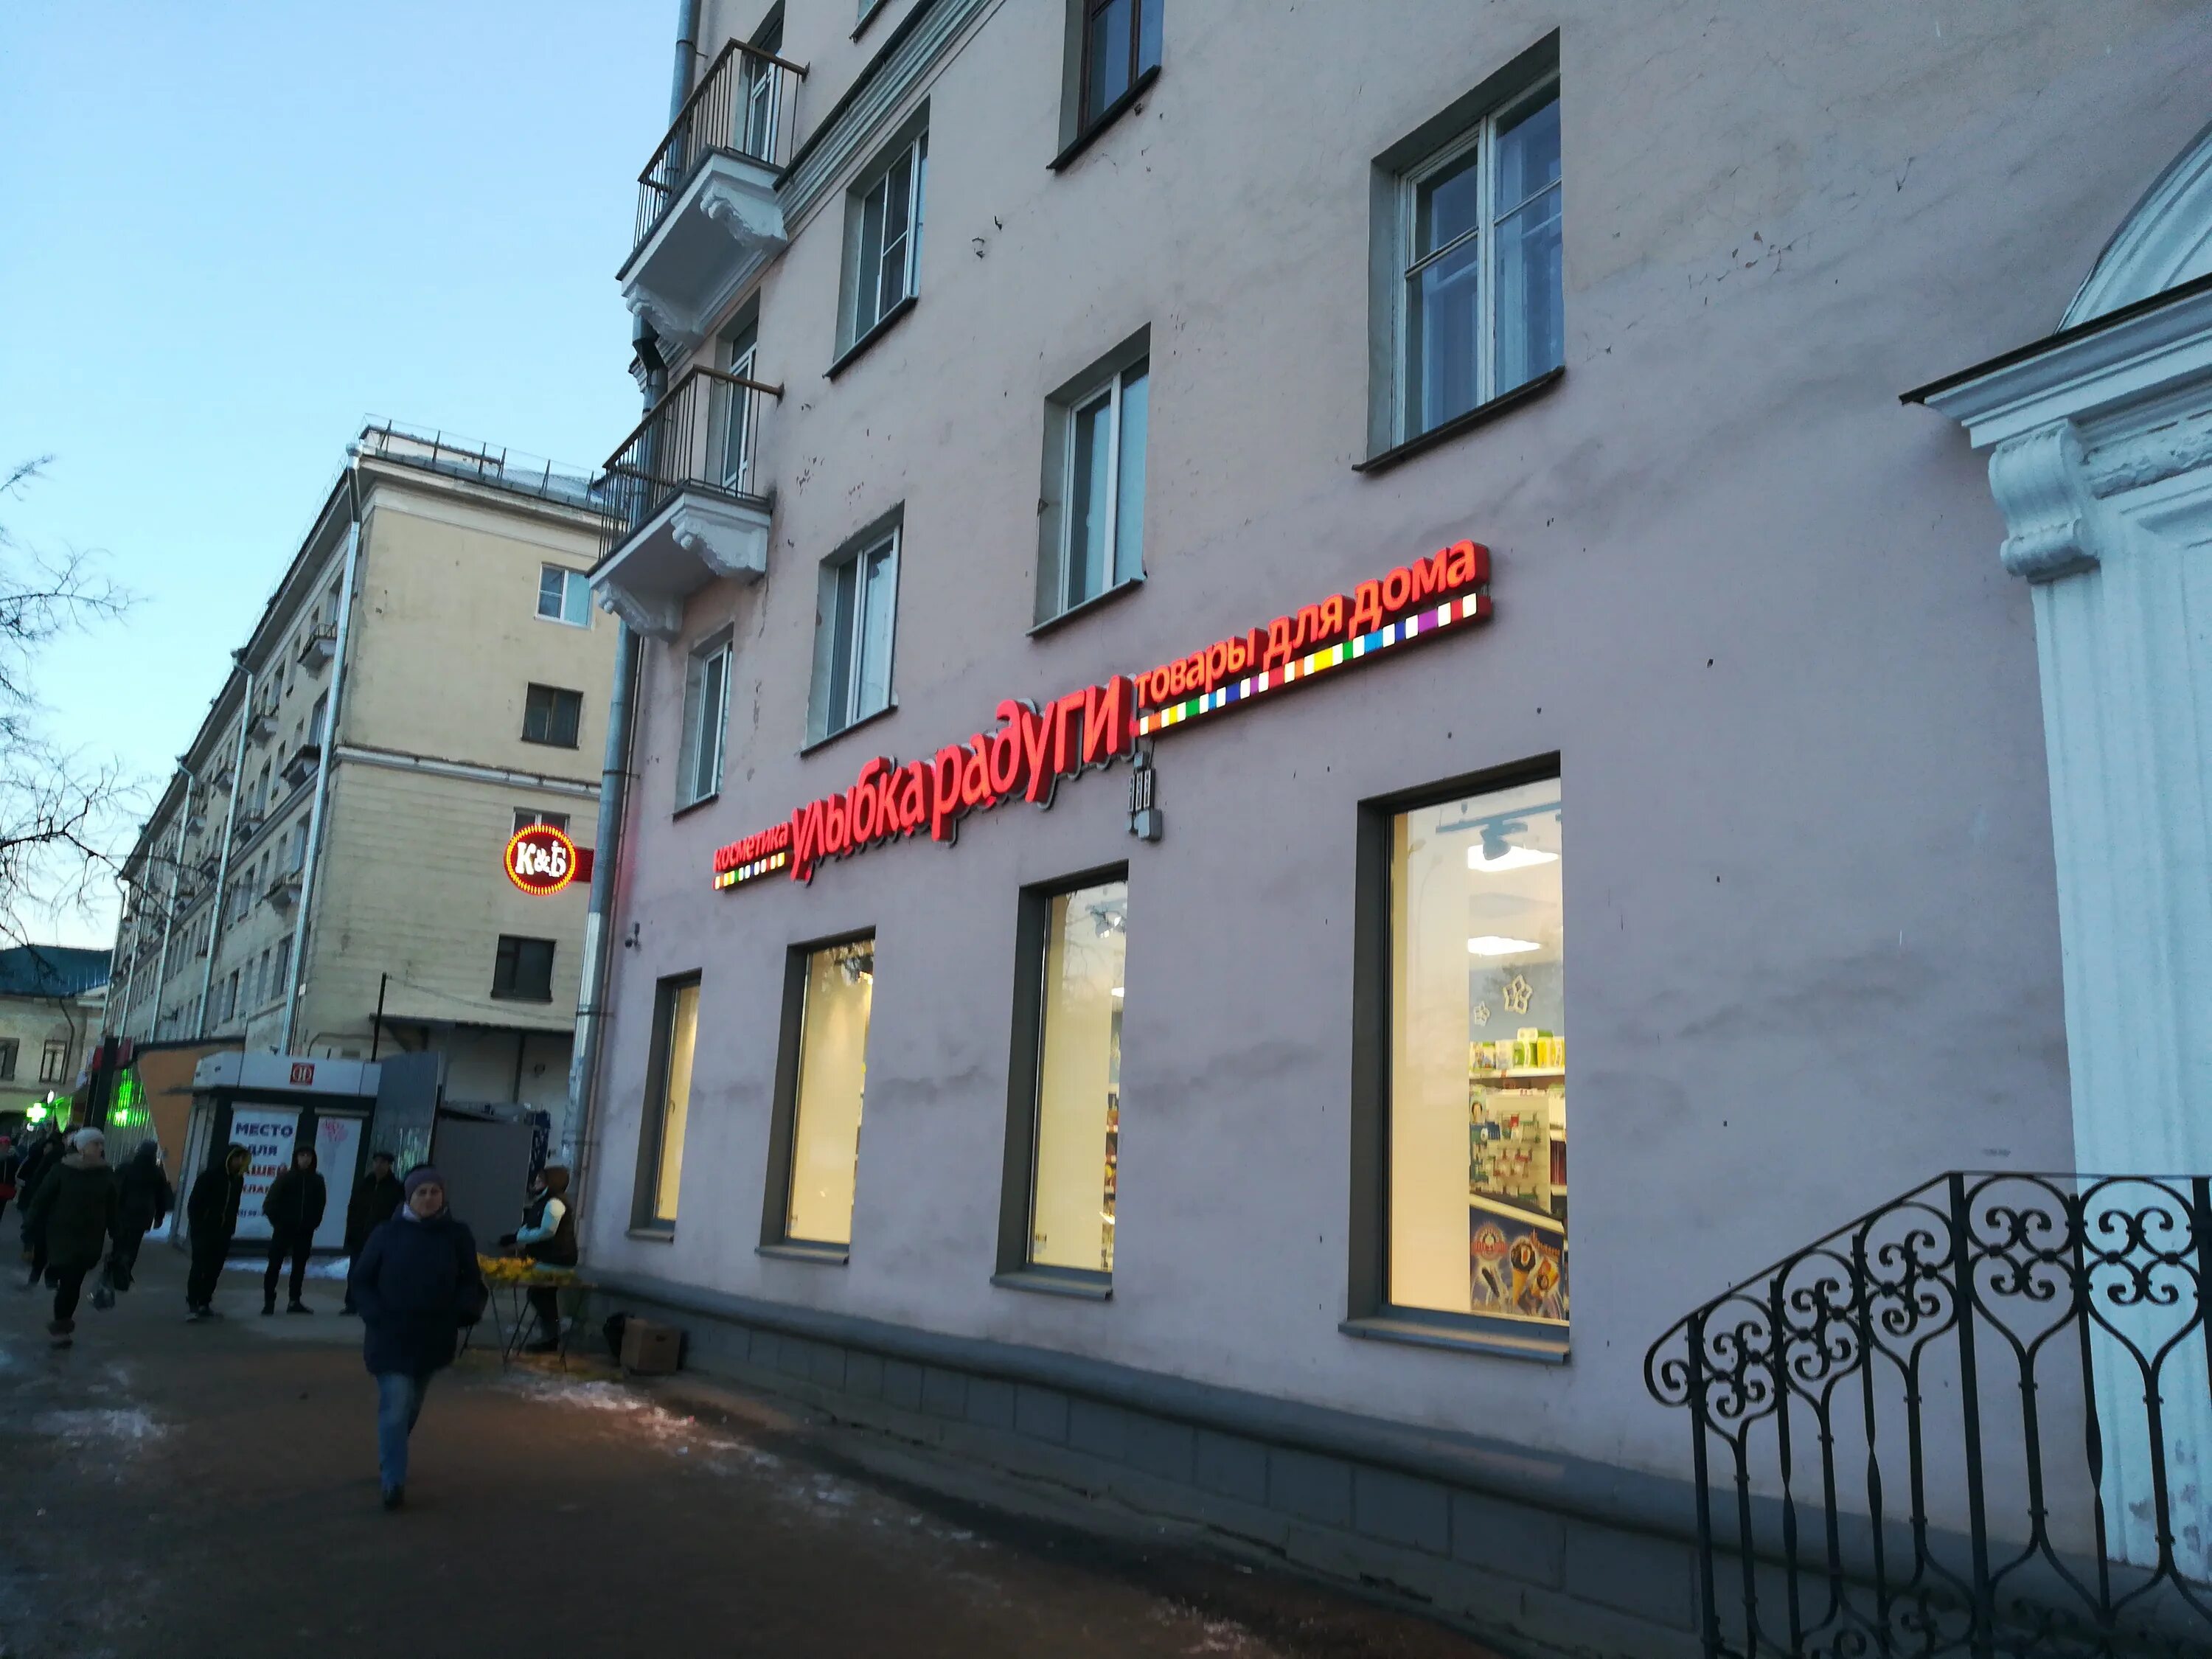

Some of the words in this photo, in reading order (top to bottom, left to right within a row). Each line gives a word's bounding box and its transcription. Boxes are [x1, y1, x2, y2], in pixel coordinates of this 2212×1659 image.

[1135, 628, 1254, 709] товары
[1262, 594, 1343, 671] для
[1348, 539, 1477, 640] дома
[931, 674, 1126, 842] радуги
[713, 821, 789, 873] косметика
[234, 1121, 293, 1138] МЕСТО
[246, 1143, 278, 1156] ДЛЯ
